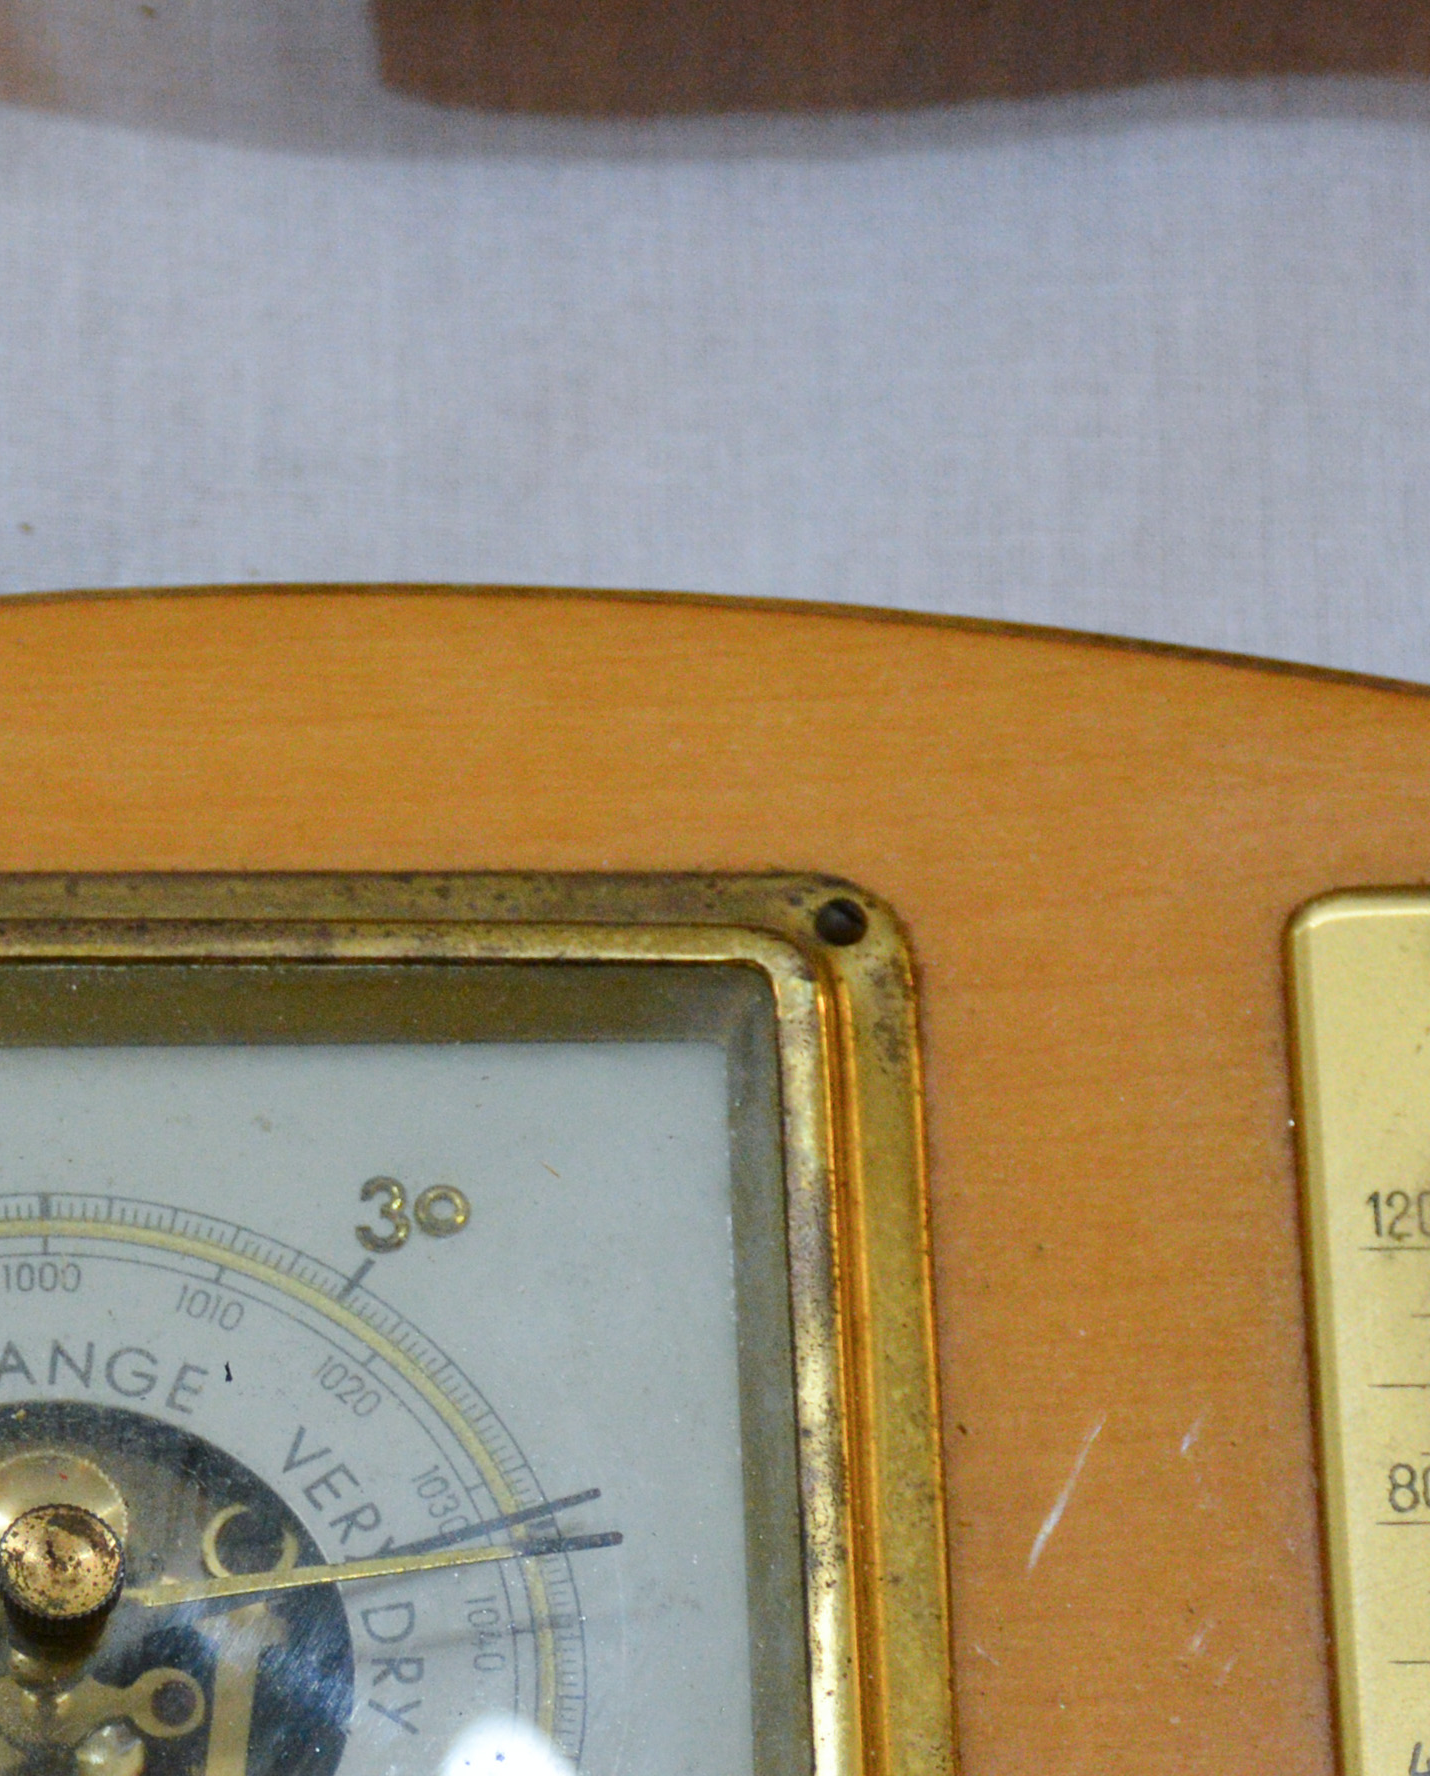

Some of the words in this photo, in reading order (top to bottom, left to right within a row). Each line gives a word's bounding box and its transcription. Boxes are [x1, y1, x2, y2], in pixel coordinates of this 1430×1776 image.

[354, 1175, 472, 1254] 30
[2, 1262, 82, 1293] 1000
[175, 1284, 246, 1332] 1010
[313, 1353, 383, 1419] 1020
[361, 1601, 426, 1736] DRY
[465, 1595, 507, 1672] 1040
